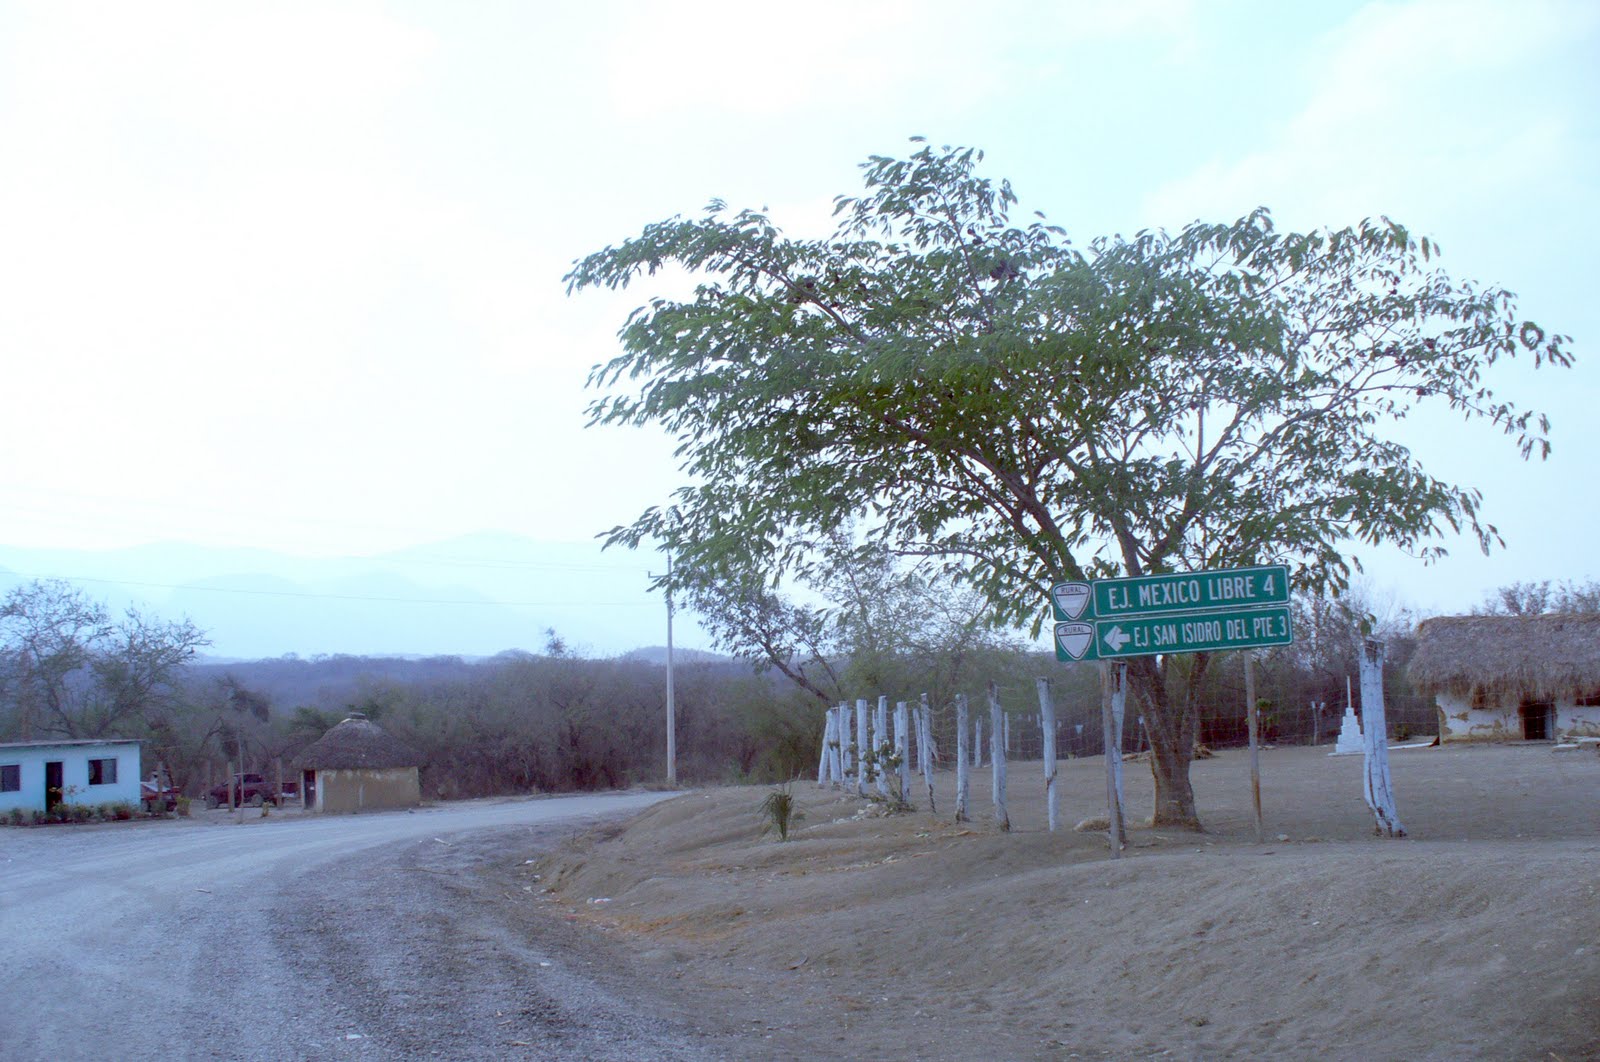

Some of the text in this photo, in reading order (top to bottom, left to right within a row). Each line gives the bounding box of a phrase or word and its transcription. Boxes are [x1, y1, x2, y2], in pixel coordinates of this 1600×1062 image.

[1061, 586, 1081, 594] RURAL
[1108, 574, 1275, 610] EJ. MEXICO LIBRE 4
[1063, 626, 1085, 634] RURAL
[1153, 624, 1177, 647] SAN
[1182, 620, 1221, 644] ISIDRO
[1226, 619, 1250, 641] DEL
[1253, 616, 1277, 638] PTE.
[1279, 615, 1288, 637] 3
